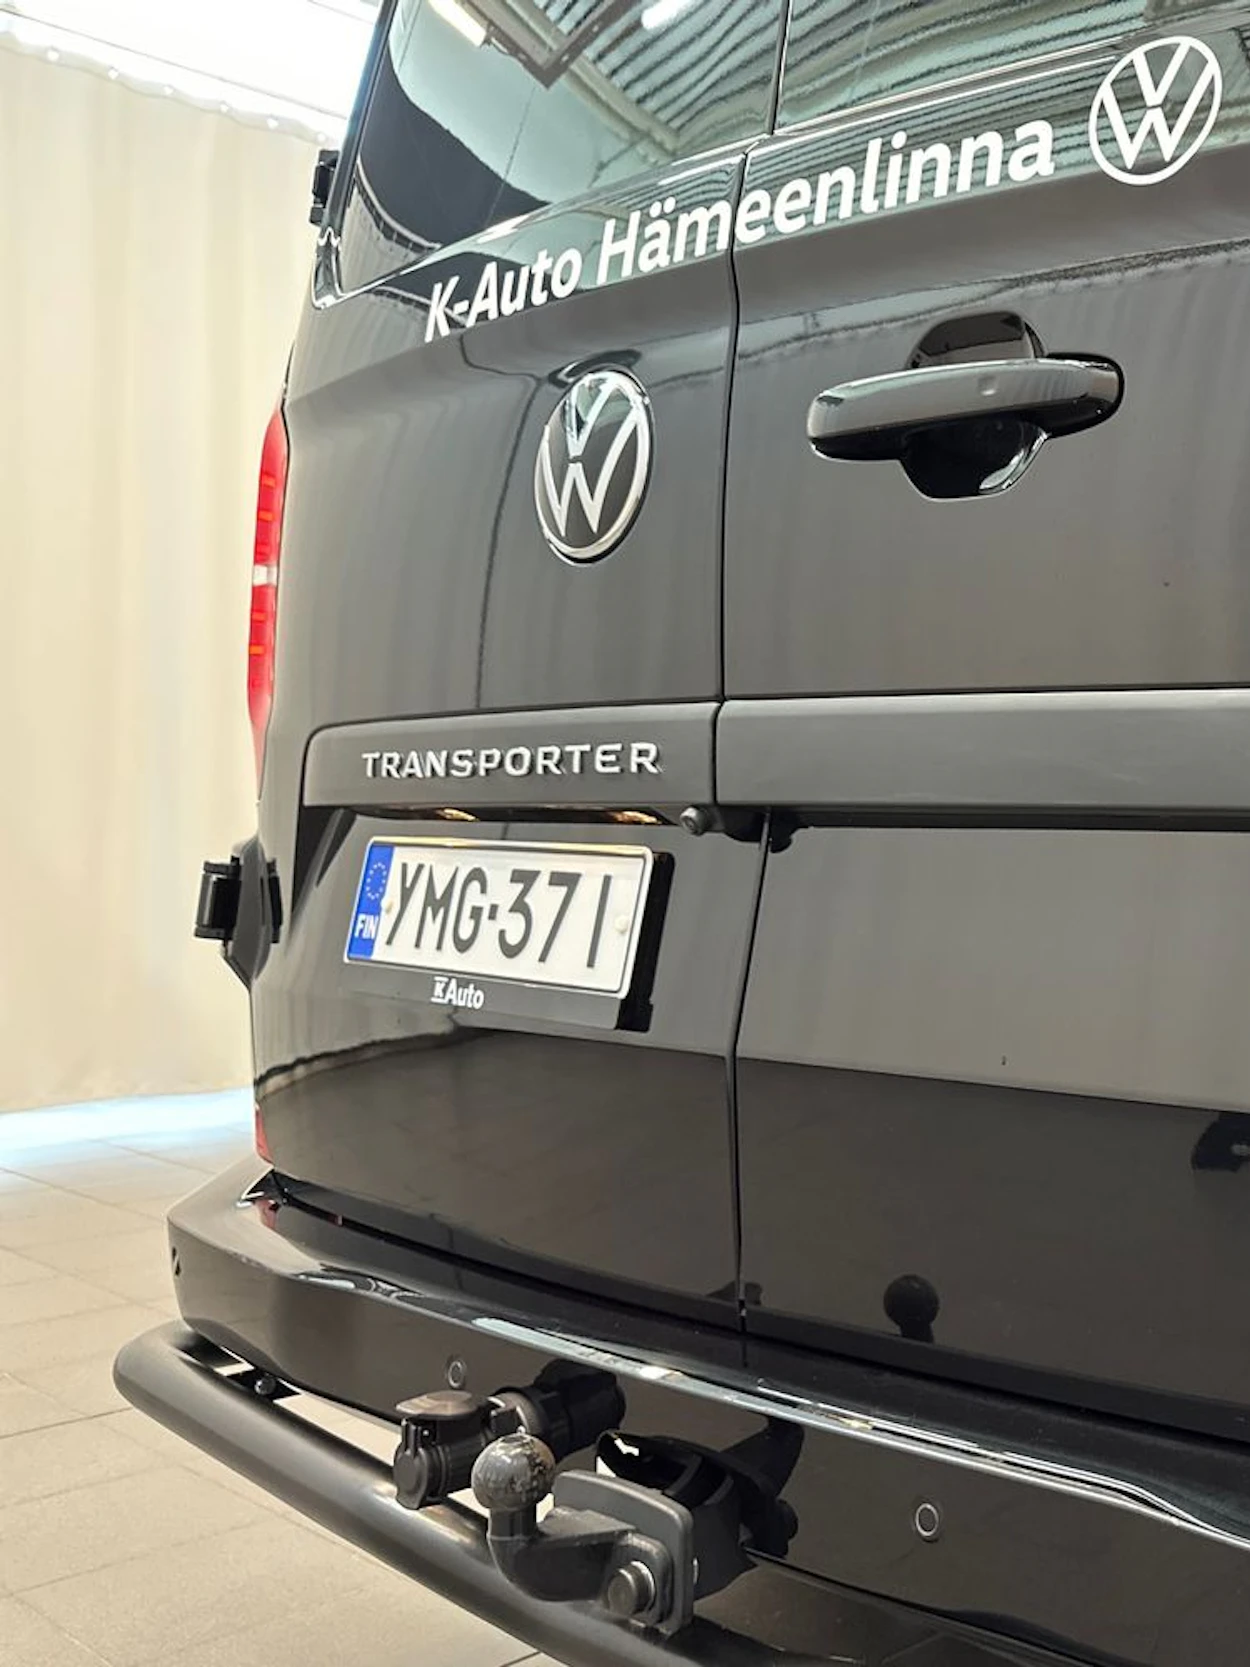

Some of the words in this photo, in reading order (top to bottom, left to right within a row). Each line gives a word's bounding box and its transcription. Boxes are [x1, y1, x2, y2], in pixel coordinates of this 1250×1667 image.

[423, 245, 583, 344] K-Auto
[597, 117, 1057, 285] Hämeenlinna
[361, 741, 665, 779] TRANSPORTER
[353, 913, 380, 939] FIN
[385, 861, 613, 968] YMG-371
